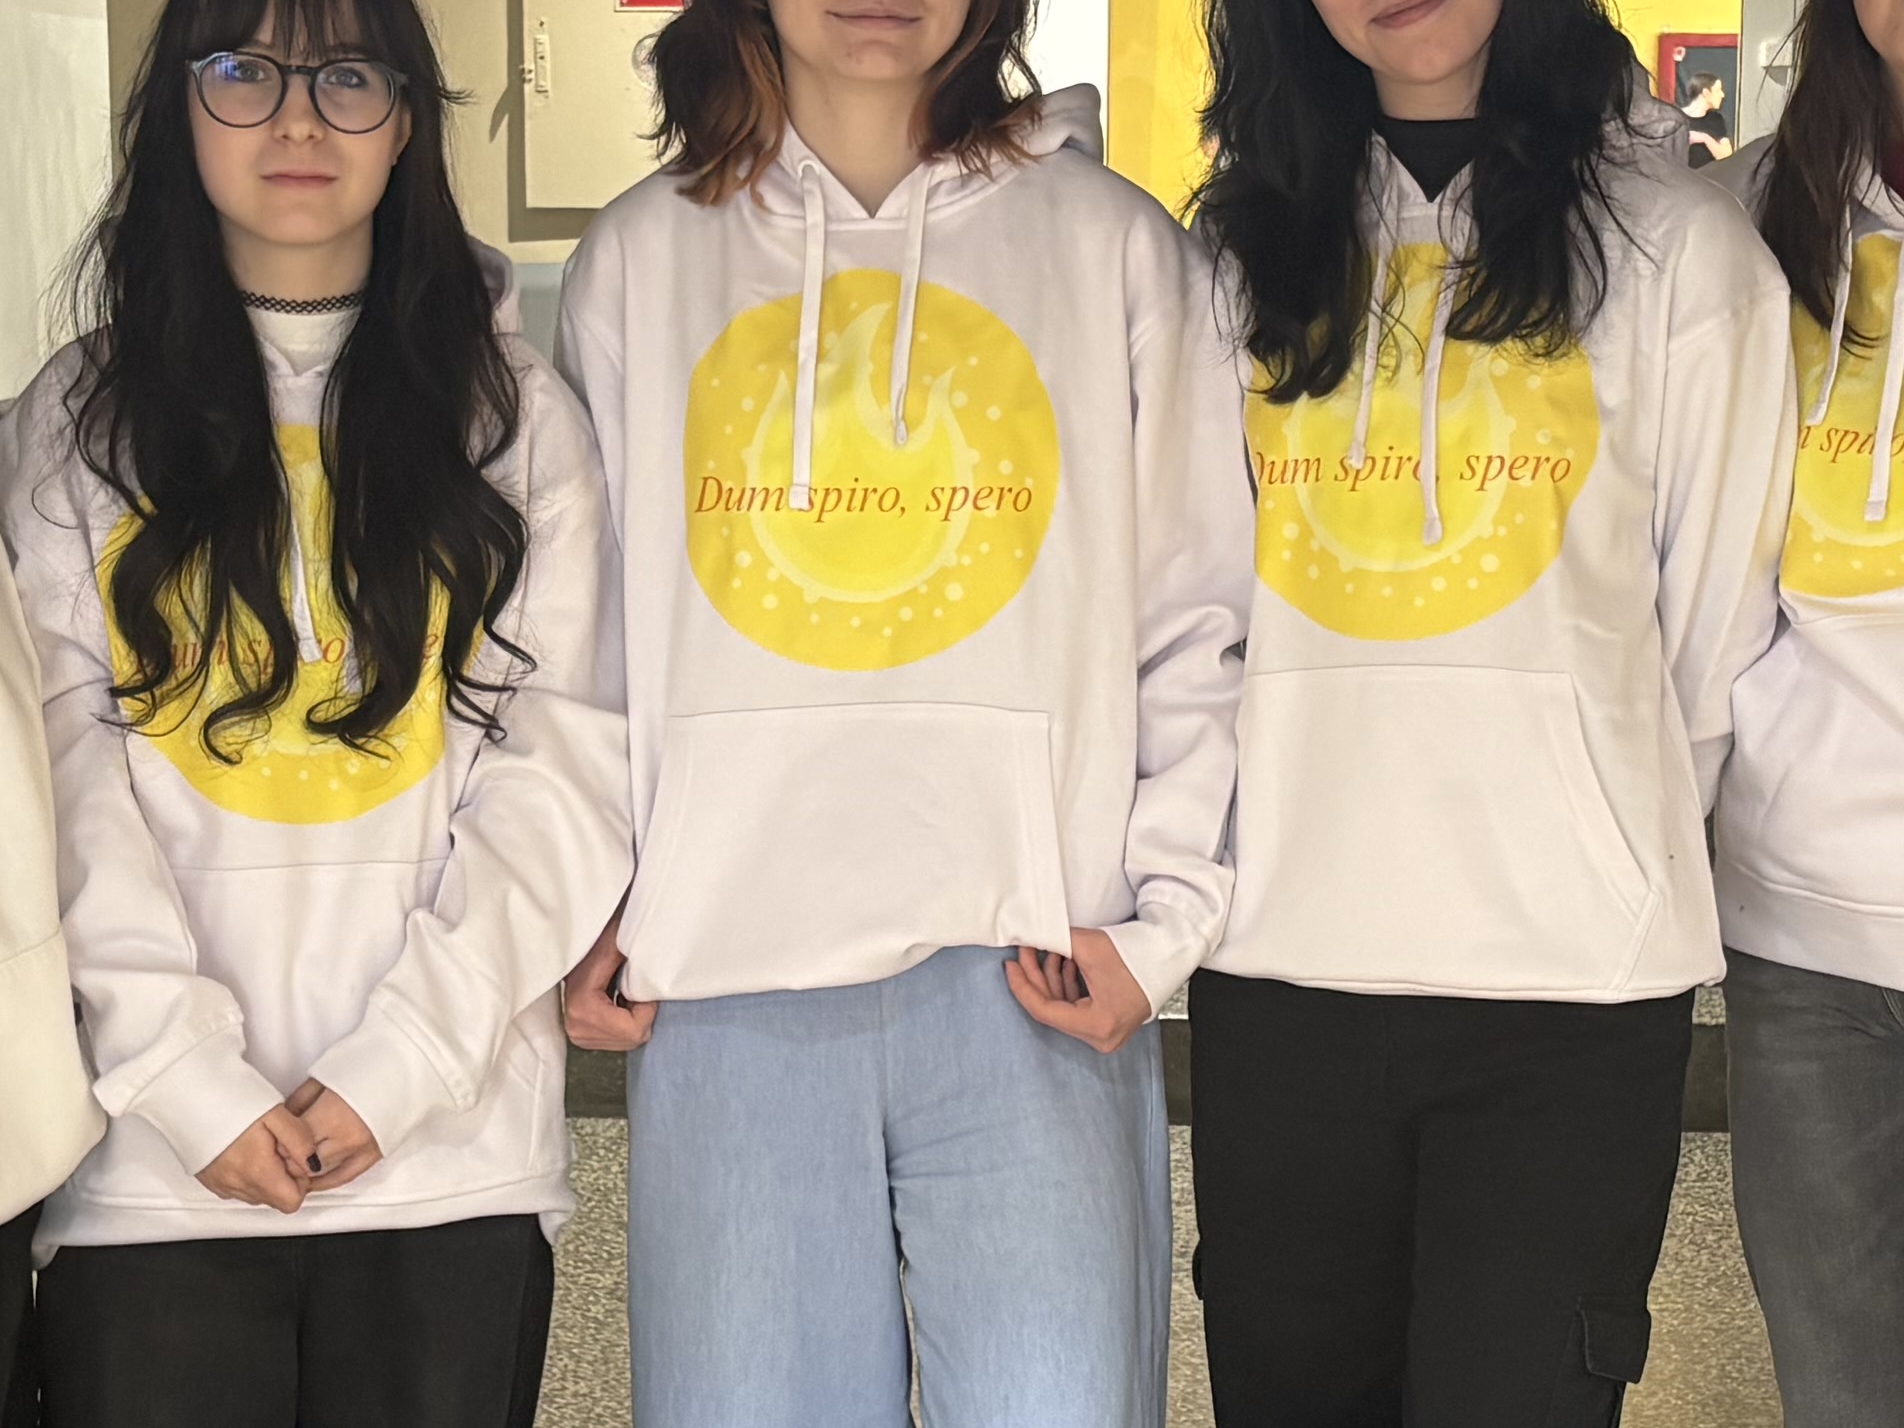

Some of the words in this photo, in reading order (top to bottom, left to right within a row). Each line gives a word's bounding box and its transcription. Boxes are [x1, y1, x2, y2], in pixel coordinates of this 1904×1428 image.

[1459, 453, 1572, 492] spero
[694, 475, 786, 513] Dum
[925, 485, 1033, 523] spero
